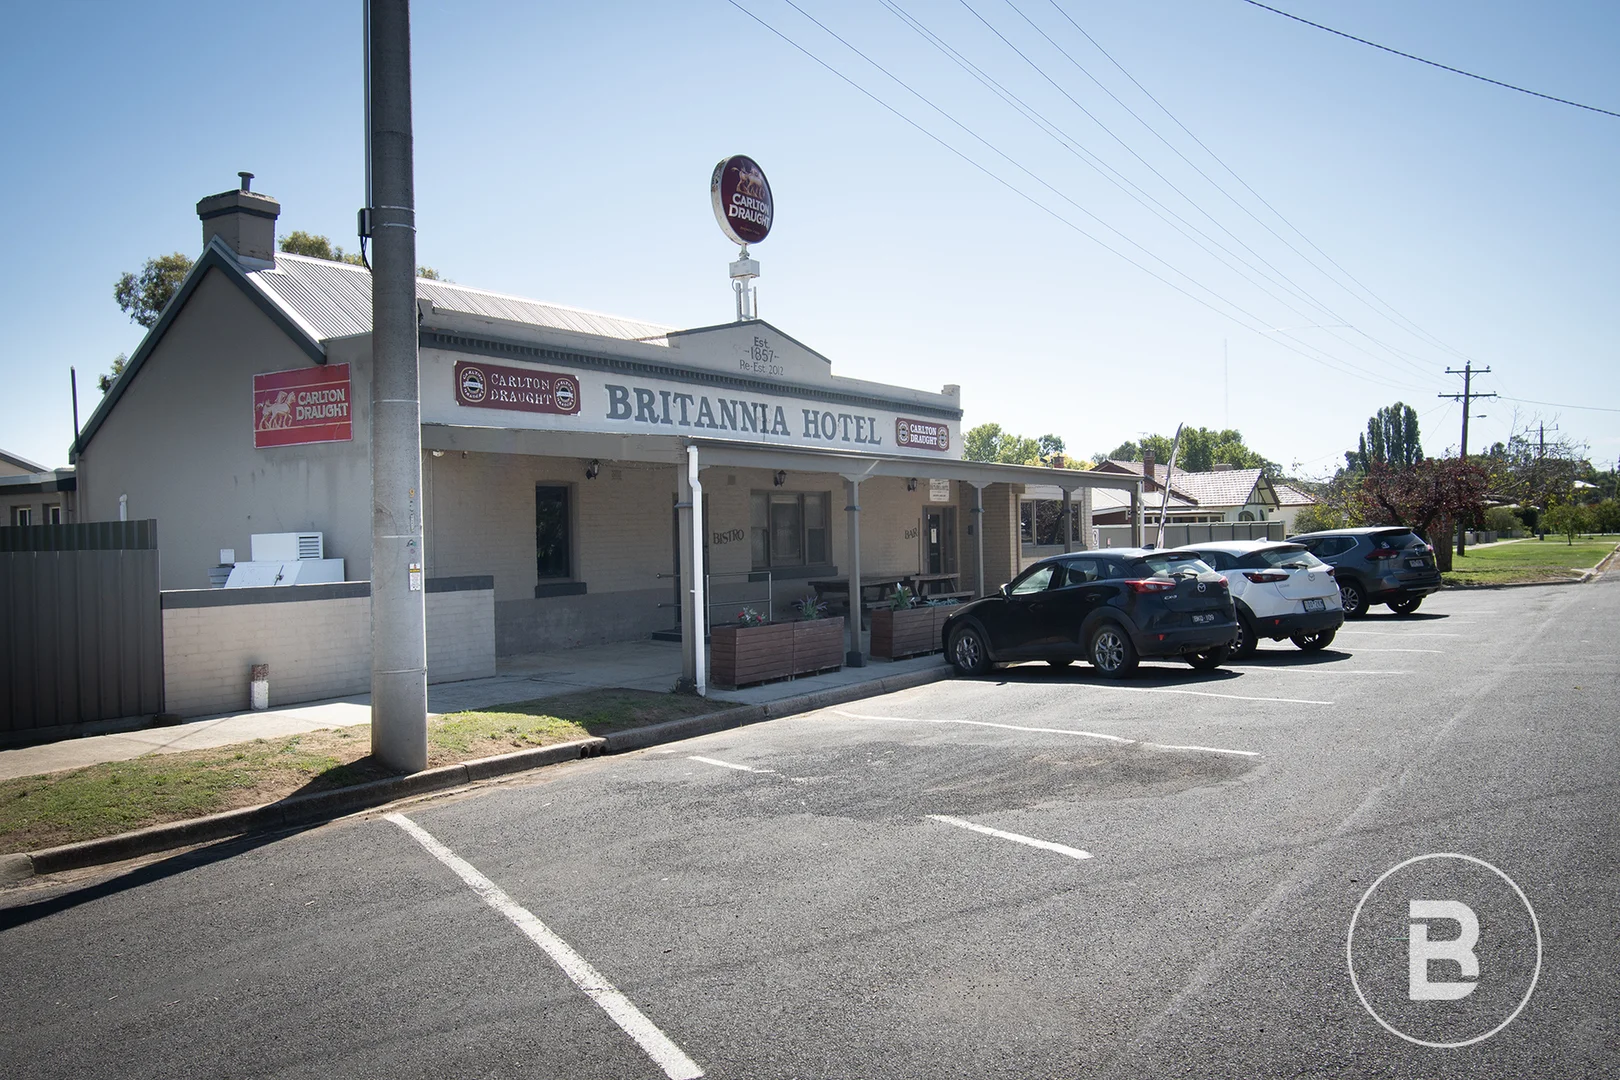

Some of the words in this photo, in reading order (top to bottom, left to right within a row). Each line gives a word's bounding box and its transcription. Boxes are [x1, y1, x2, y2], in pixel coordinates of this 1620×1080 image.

[732, 193, 770, 216] CARLTON
[728, 204, 771, 230] DRAUGHT
[491, 373, 550, 390] CARLTON
[297, 388, 346, 406] CARLTON
[491, 389, 552, 405] DRAUGHT
[296, 403, 349, 421] DRAUGHT
[605, 384, 790, 436] BRITANNIA
[802, 409, 882, 445] HOTEL
[910, 423, 937, 436] CARLTON
[910, 434, 938, 446] DRAUGHT
[713, 529, 745, 545] BISTRO
[904, 527, 918, 540] BAR
